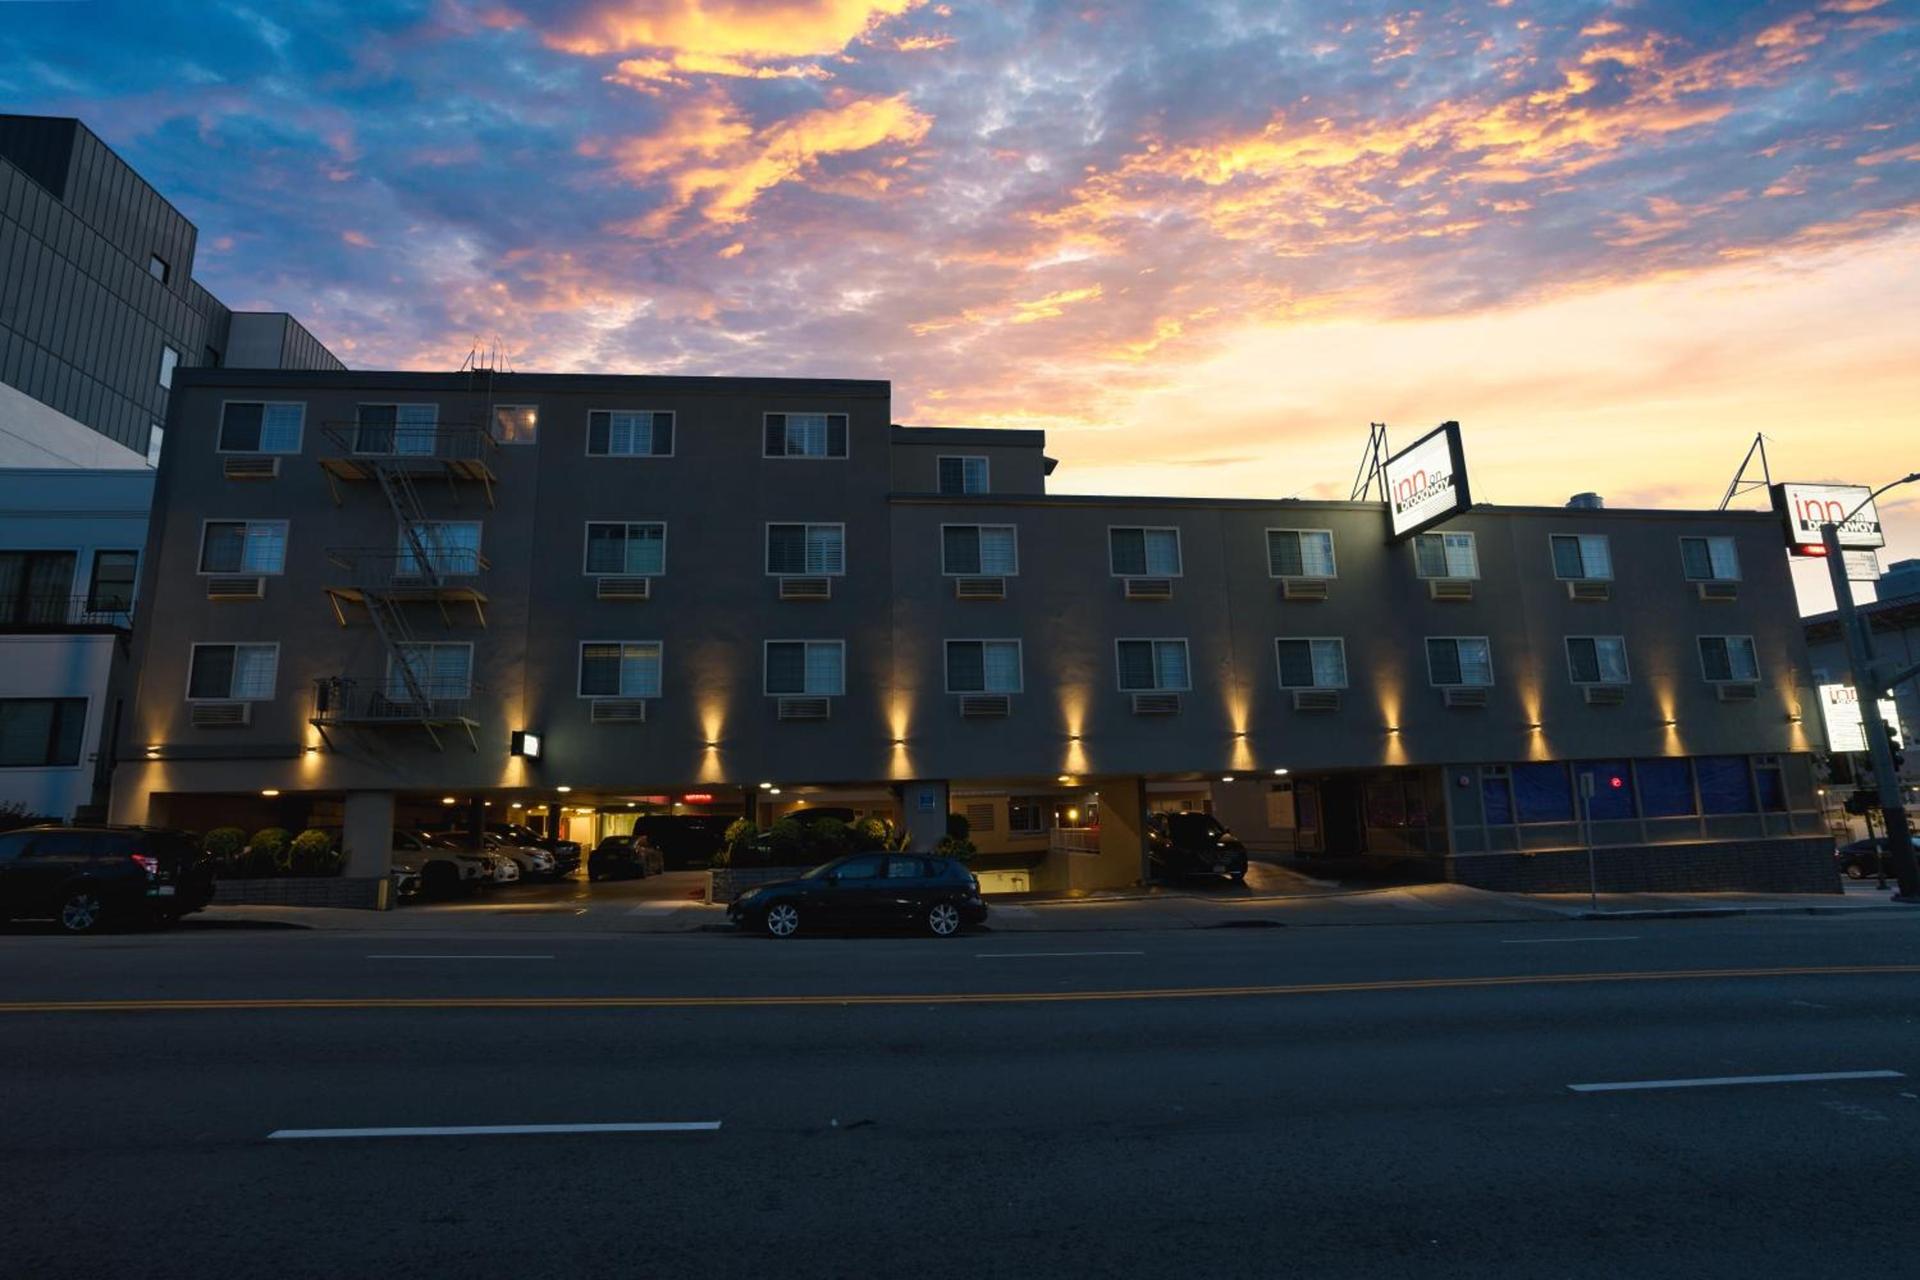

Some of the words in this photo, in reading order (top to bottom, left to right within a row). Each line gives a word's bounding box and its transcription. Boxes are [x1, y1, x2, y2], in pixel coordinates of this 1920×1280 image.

[1392, 470, 1427, 504] inn
[1402, 478, 1449, 512] broadway
[1794, 493, 1845, 522] inn
